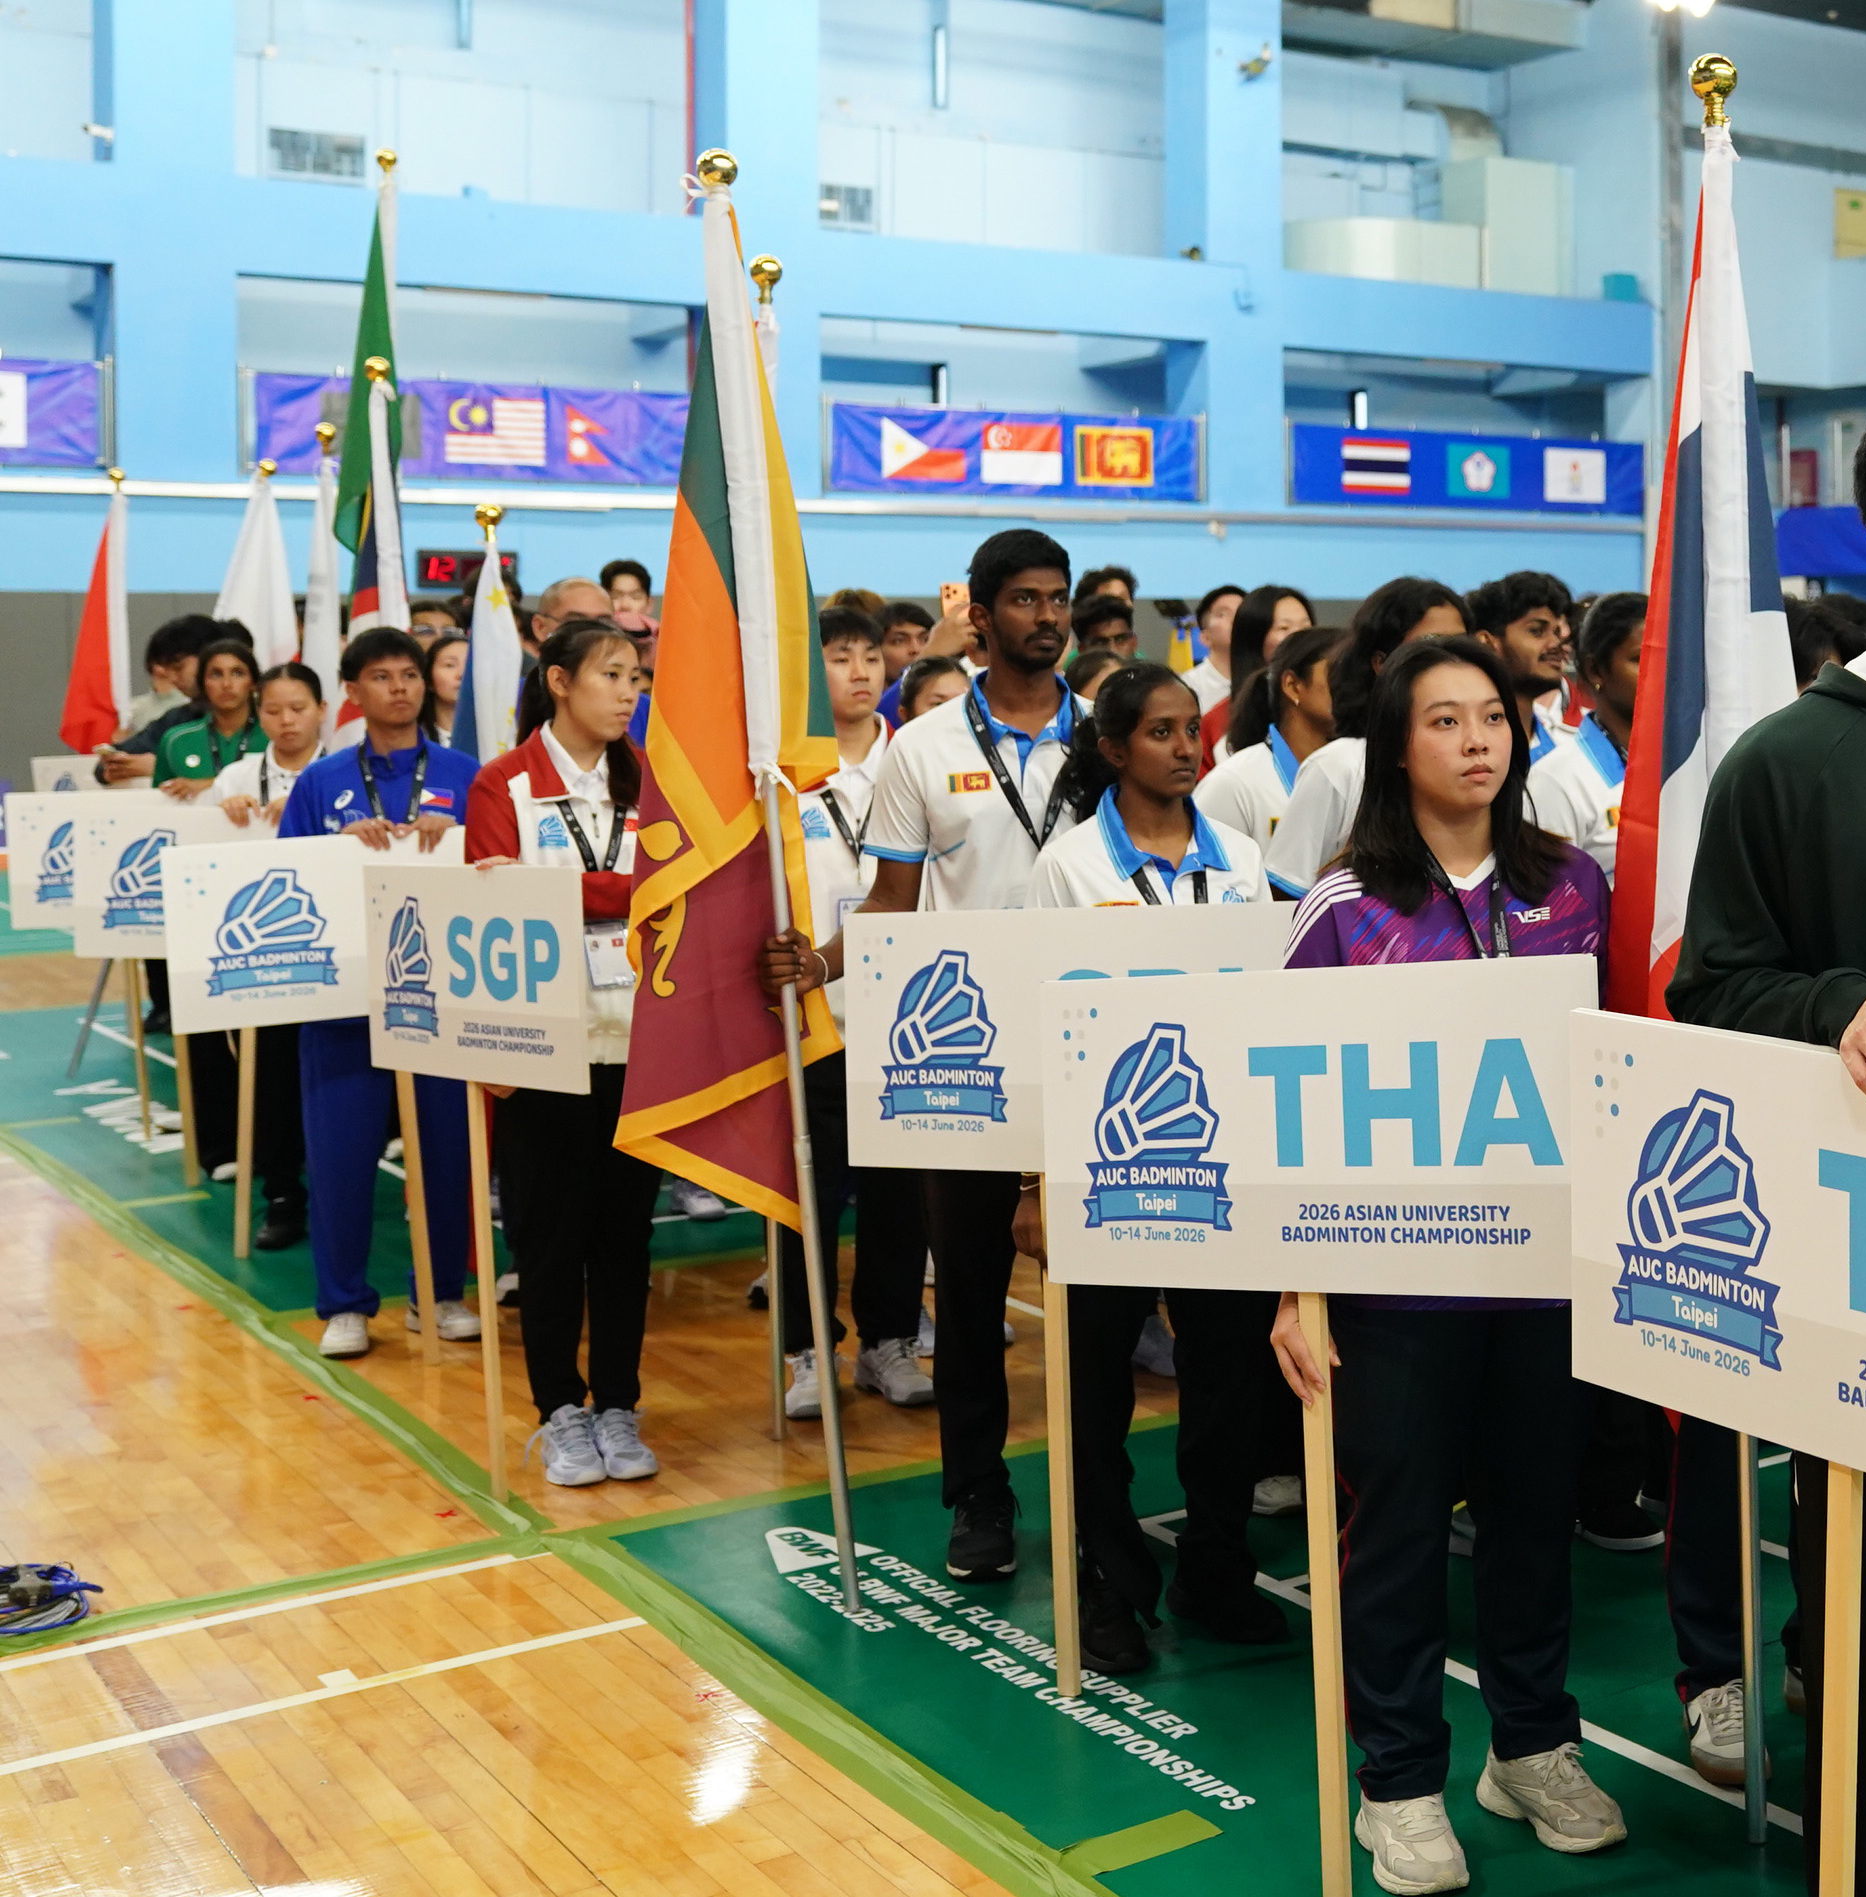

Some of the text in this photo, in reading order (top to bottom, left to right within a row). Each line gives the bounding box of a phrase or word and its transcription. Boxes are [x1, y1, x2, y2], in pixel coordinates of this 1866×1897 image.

[217, 950, 326, 970] AUC BADMINTON
[447, 915, 560, 1002] SGP
[481, 1023, 501, 1036] ASIAN
[503, 1025, 545, 1040] UNIVERSITY
[457, 1035, 554, 1056] BADMINTON CHAMPIONSHIP
[890, 1068, 994, 1087] AUC BADMINTON
[924, 1090, 959, 1110] Taipei
[1248, 1038, 1564, 1167] THA
[901, 1119, 984, 1132] 10-14 June 2026
[1096, 1166, 1217, 1188] AUC BADMINTON
[1135, 1193, 1177, 1216] Taipei
[1299, 1203, 1510, 1222] 2026 ASIAN UNIVERSITY
[1109, 1227, 1205, 1243] 10-14 June 2026
[1281, 1226, 1531, 1245] BADMINTON CHAMPIONSHIP
[1627, 1254, 1765, 1312] AUC BADMINTON
[1671, 1295, 1718, 1330] Taipei
[1640, 1328, 1750, 1377] 10-14 June 2026
[869, 1555, 965, 1608] OFFICIAL
[1080, 1669, 1199, 1740] SUPPLIER
[895, 1604, 983, 1652] MAJOR
[970, 1647, 1049, 1689] TEAM
[1034, 1687, 1256, 1810] CHAMPIONSHIPS
